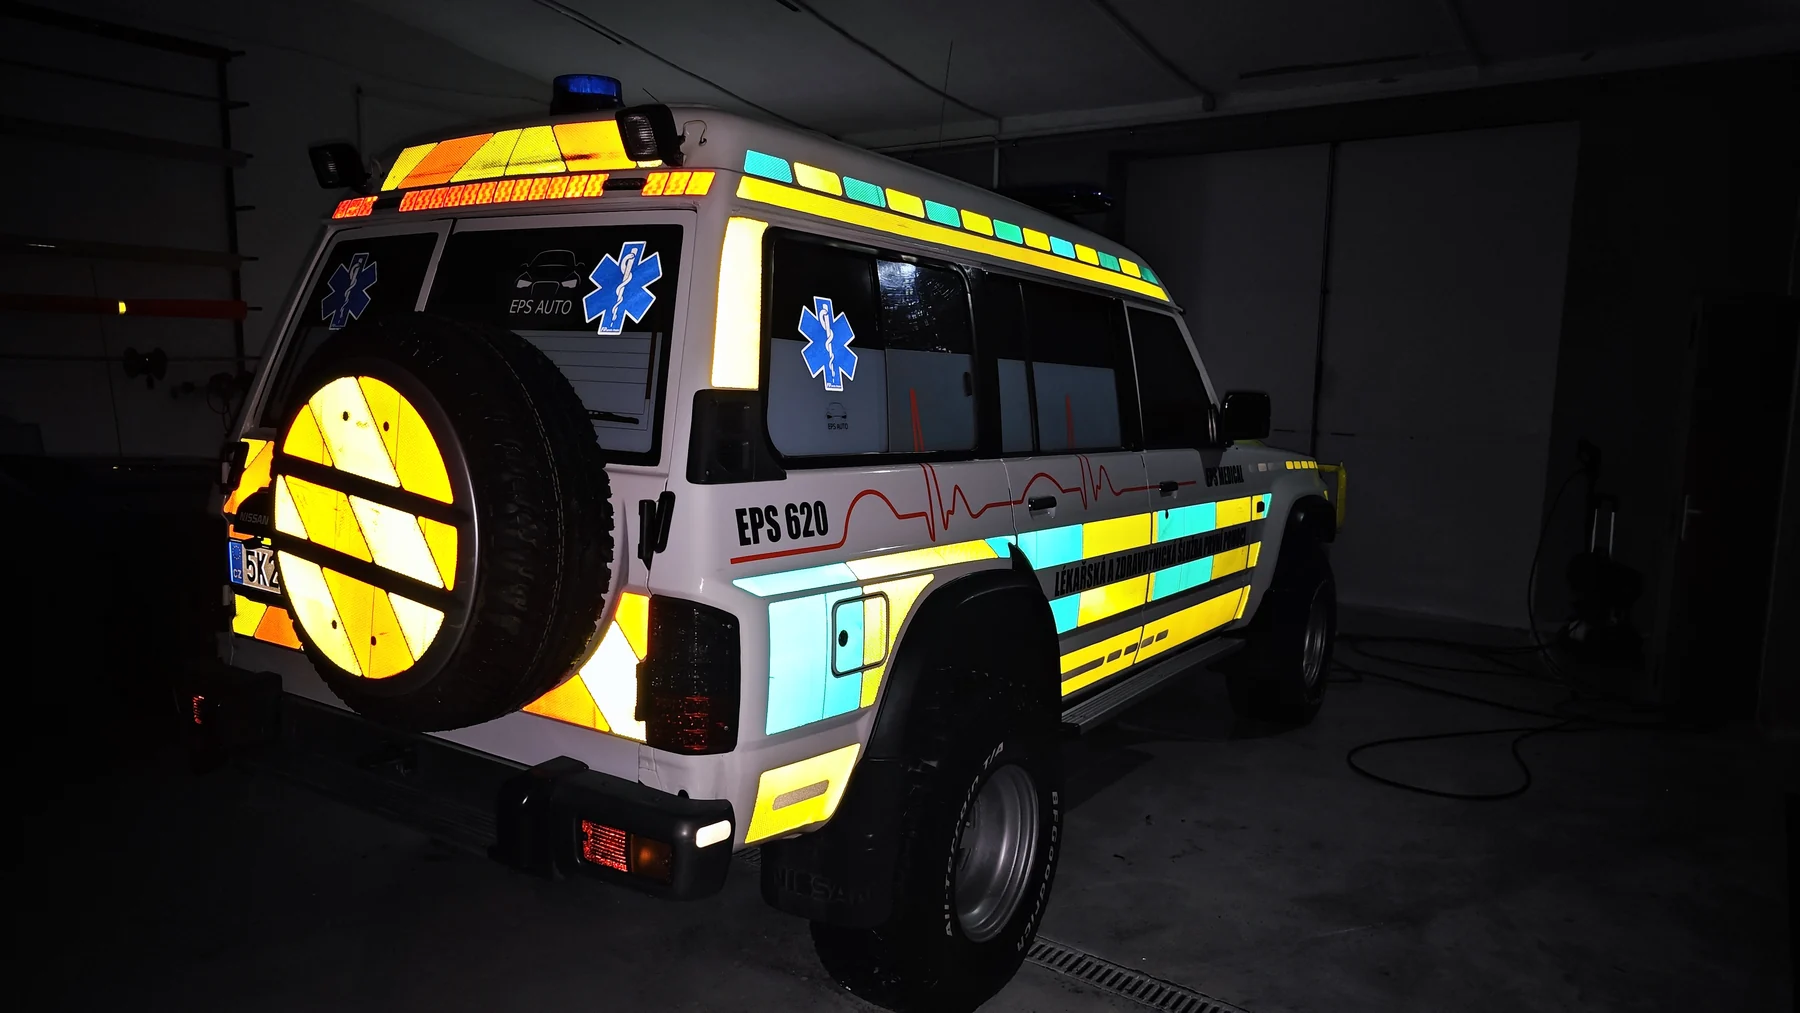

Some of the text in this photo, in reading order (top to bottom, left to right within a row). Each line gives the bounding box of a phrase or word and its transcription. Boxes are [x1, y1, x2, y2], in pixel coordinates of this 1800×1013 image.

[509, 299, 572, 315] EPS AUTO
[827, 422, 849, 430] EPS AUTO
[239, 511, 270, 526] NISSAN
[735, 500, 829, 547] EPS 620
[233, 568, 243, 579] CZ
[1054, 556, 1107, 597] LÉKAŘSKÁ
[1107, 569, 1115, 585] A
